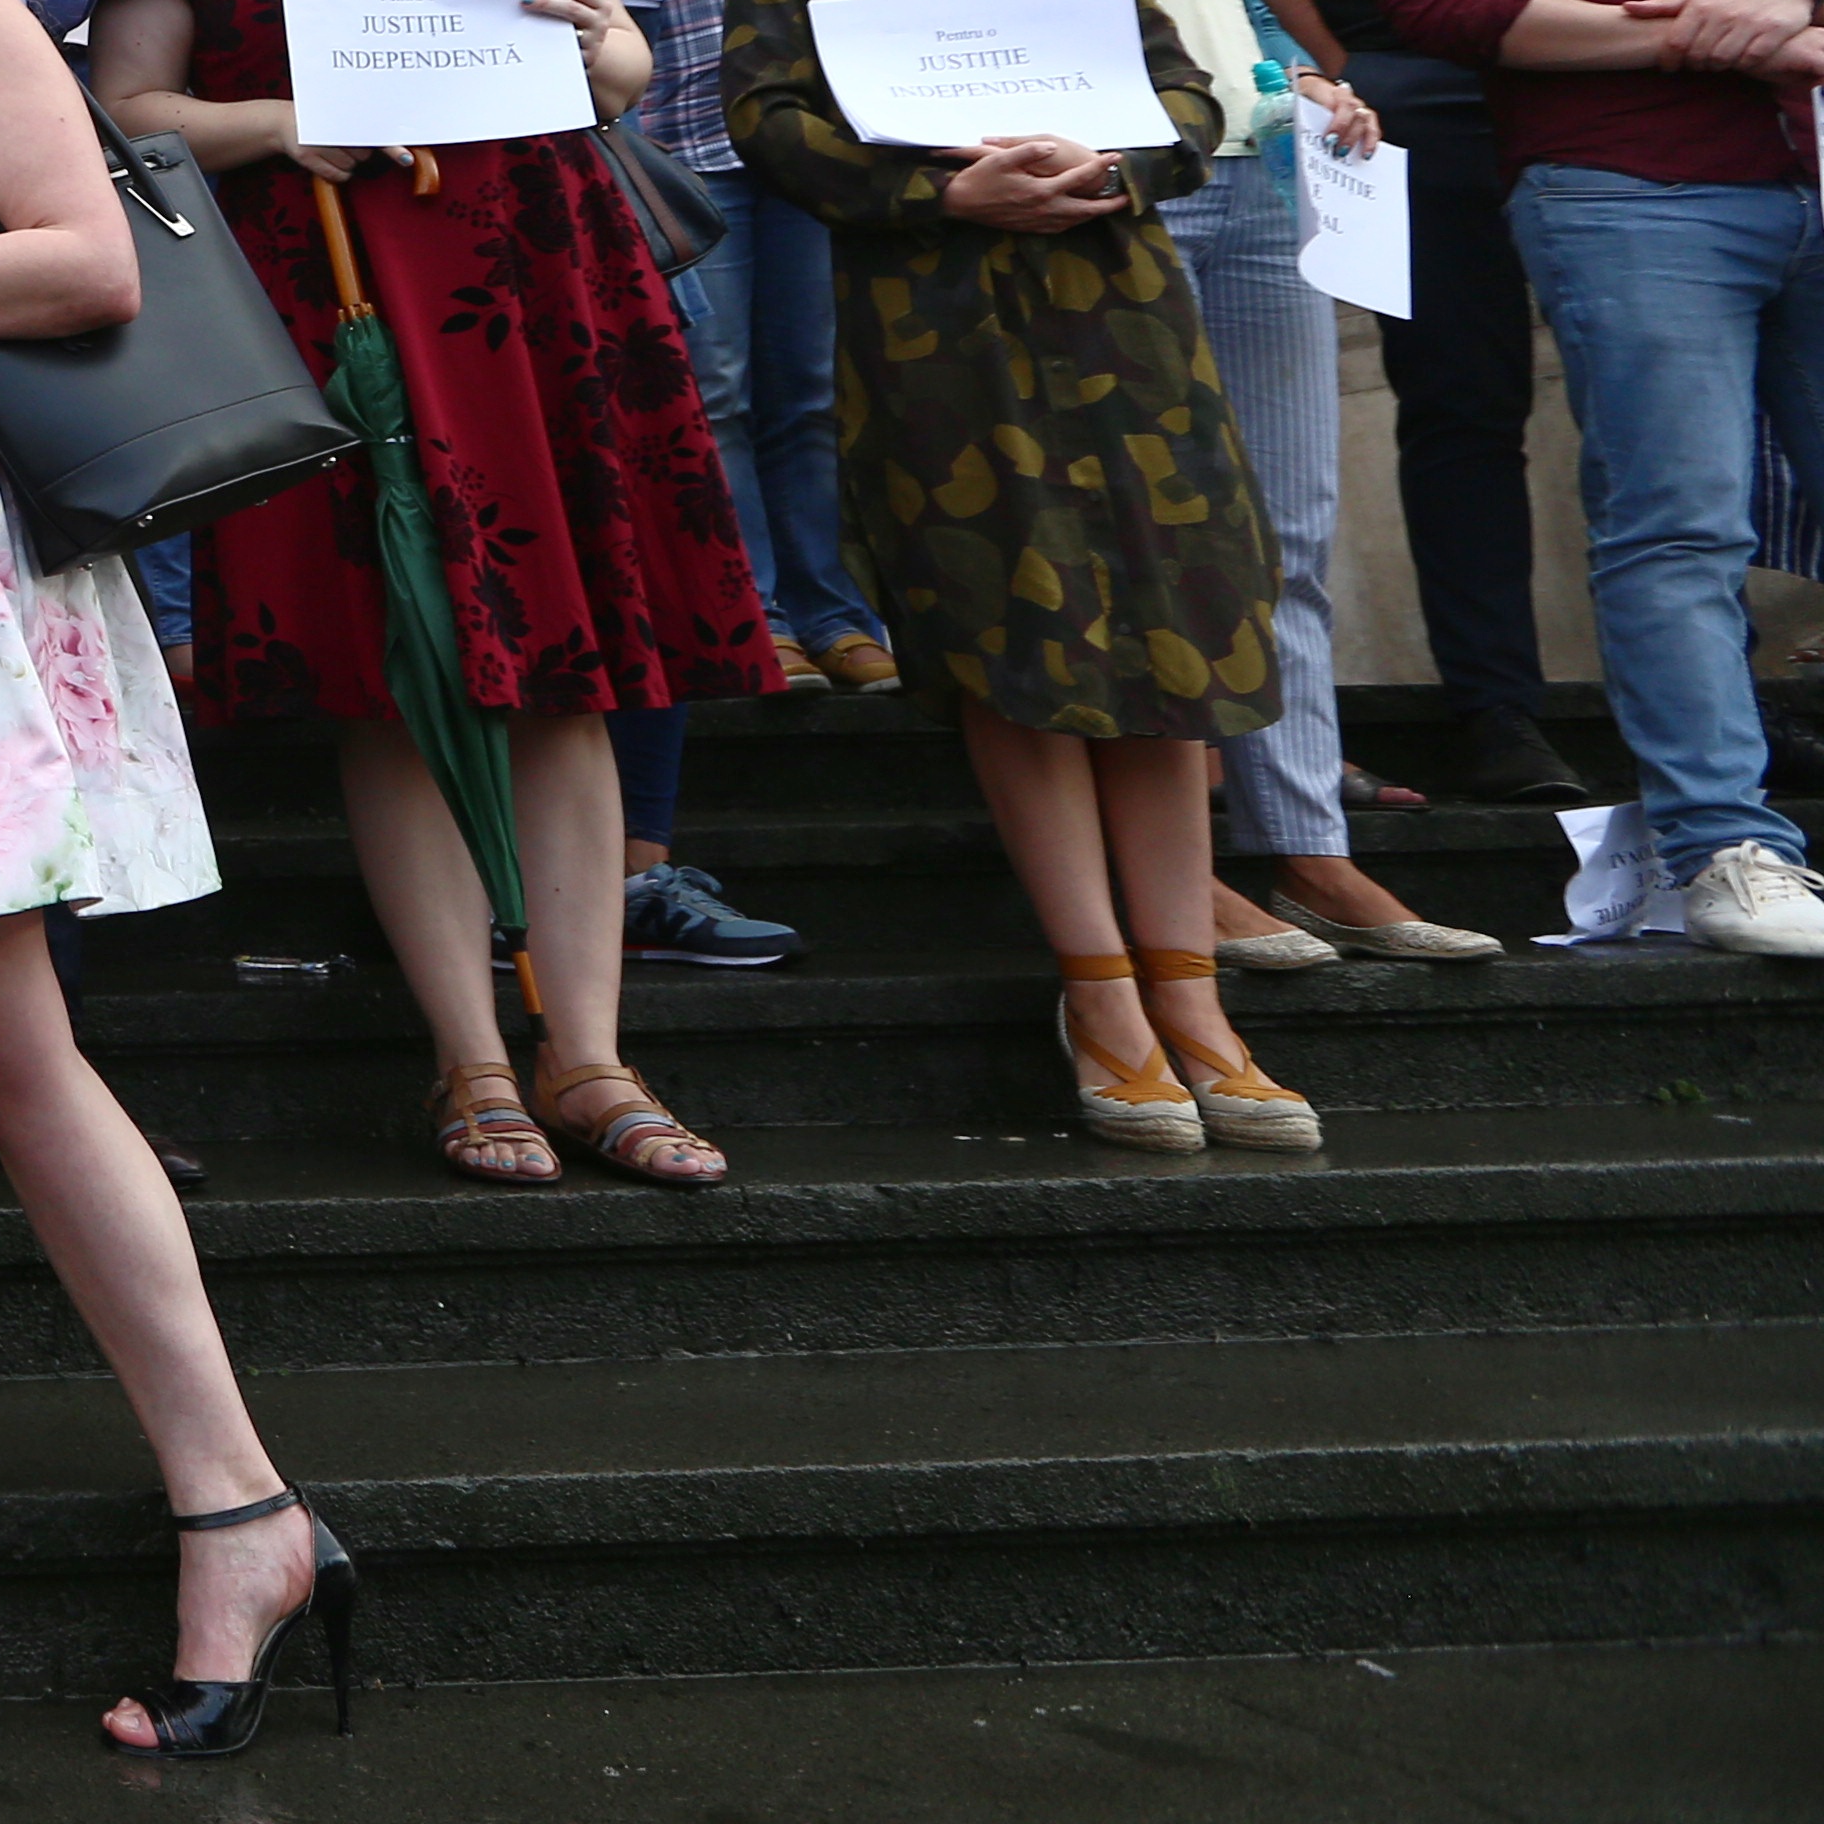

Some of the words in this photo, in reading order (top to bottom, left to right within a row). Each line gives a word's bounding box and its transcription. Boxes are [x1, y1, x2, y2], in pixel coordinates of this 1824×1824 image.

[361, 14, 465, 37] JUSTIȚIE
[935, 29, 983, 42] Pentru
[986, 28, 997, 37] o
[331, 42, 524, 70] INDEPENDENTĂ
[918, 47, 1031, 72] JUSTIȚIE
[889, 71, 1095, 99] INDEPENDENTĂ
